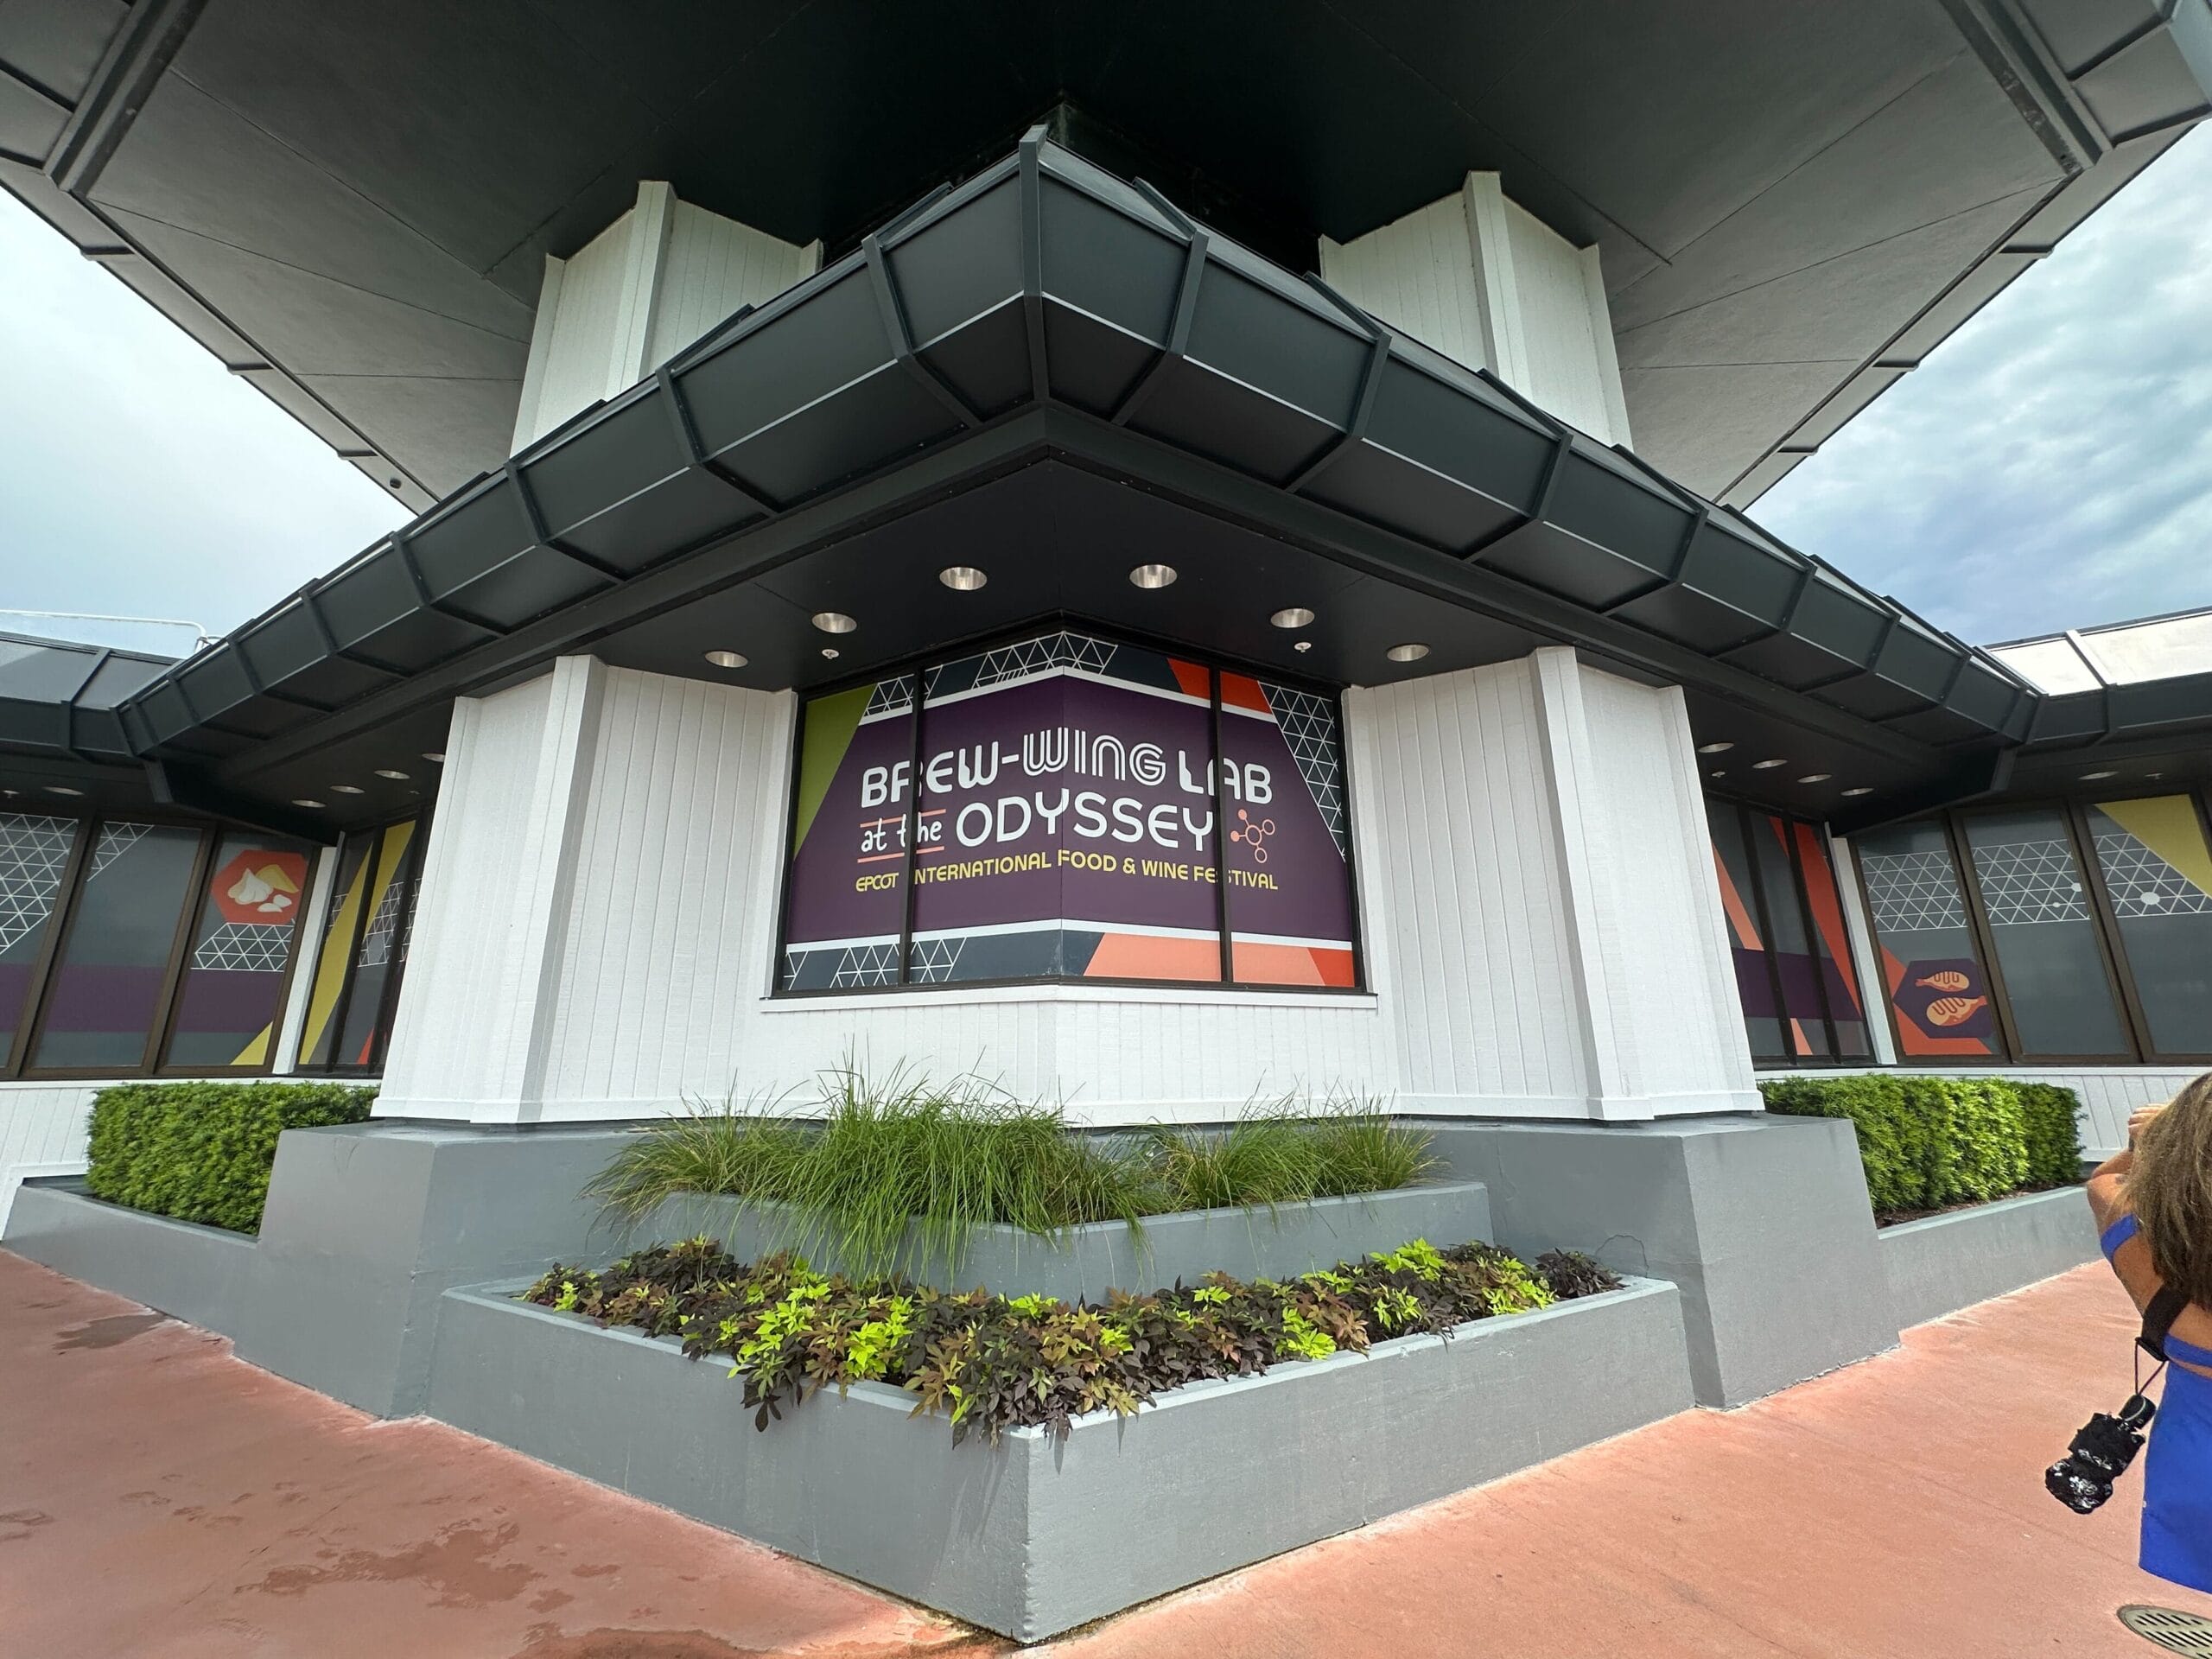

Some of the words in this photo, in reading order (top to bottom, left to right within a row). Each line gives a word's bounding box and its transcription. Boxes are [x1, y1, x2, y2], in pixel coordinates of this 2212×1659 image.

[1178, 749, 1273, 804] LAB
[861, 817, 887, 852] at
[896, 811, 943, 848] the
[956, 788, 1213, 852] ODYSSEY
[855, 872, 899, 892] EPCOT
[914, 851, 1052, 886] NTERNATIONAL
[1058, 849, 1117, 872] FOOD
[1122, 857, 1136, 875] &
[1141, 859, 1188, 880] WINE
